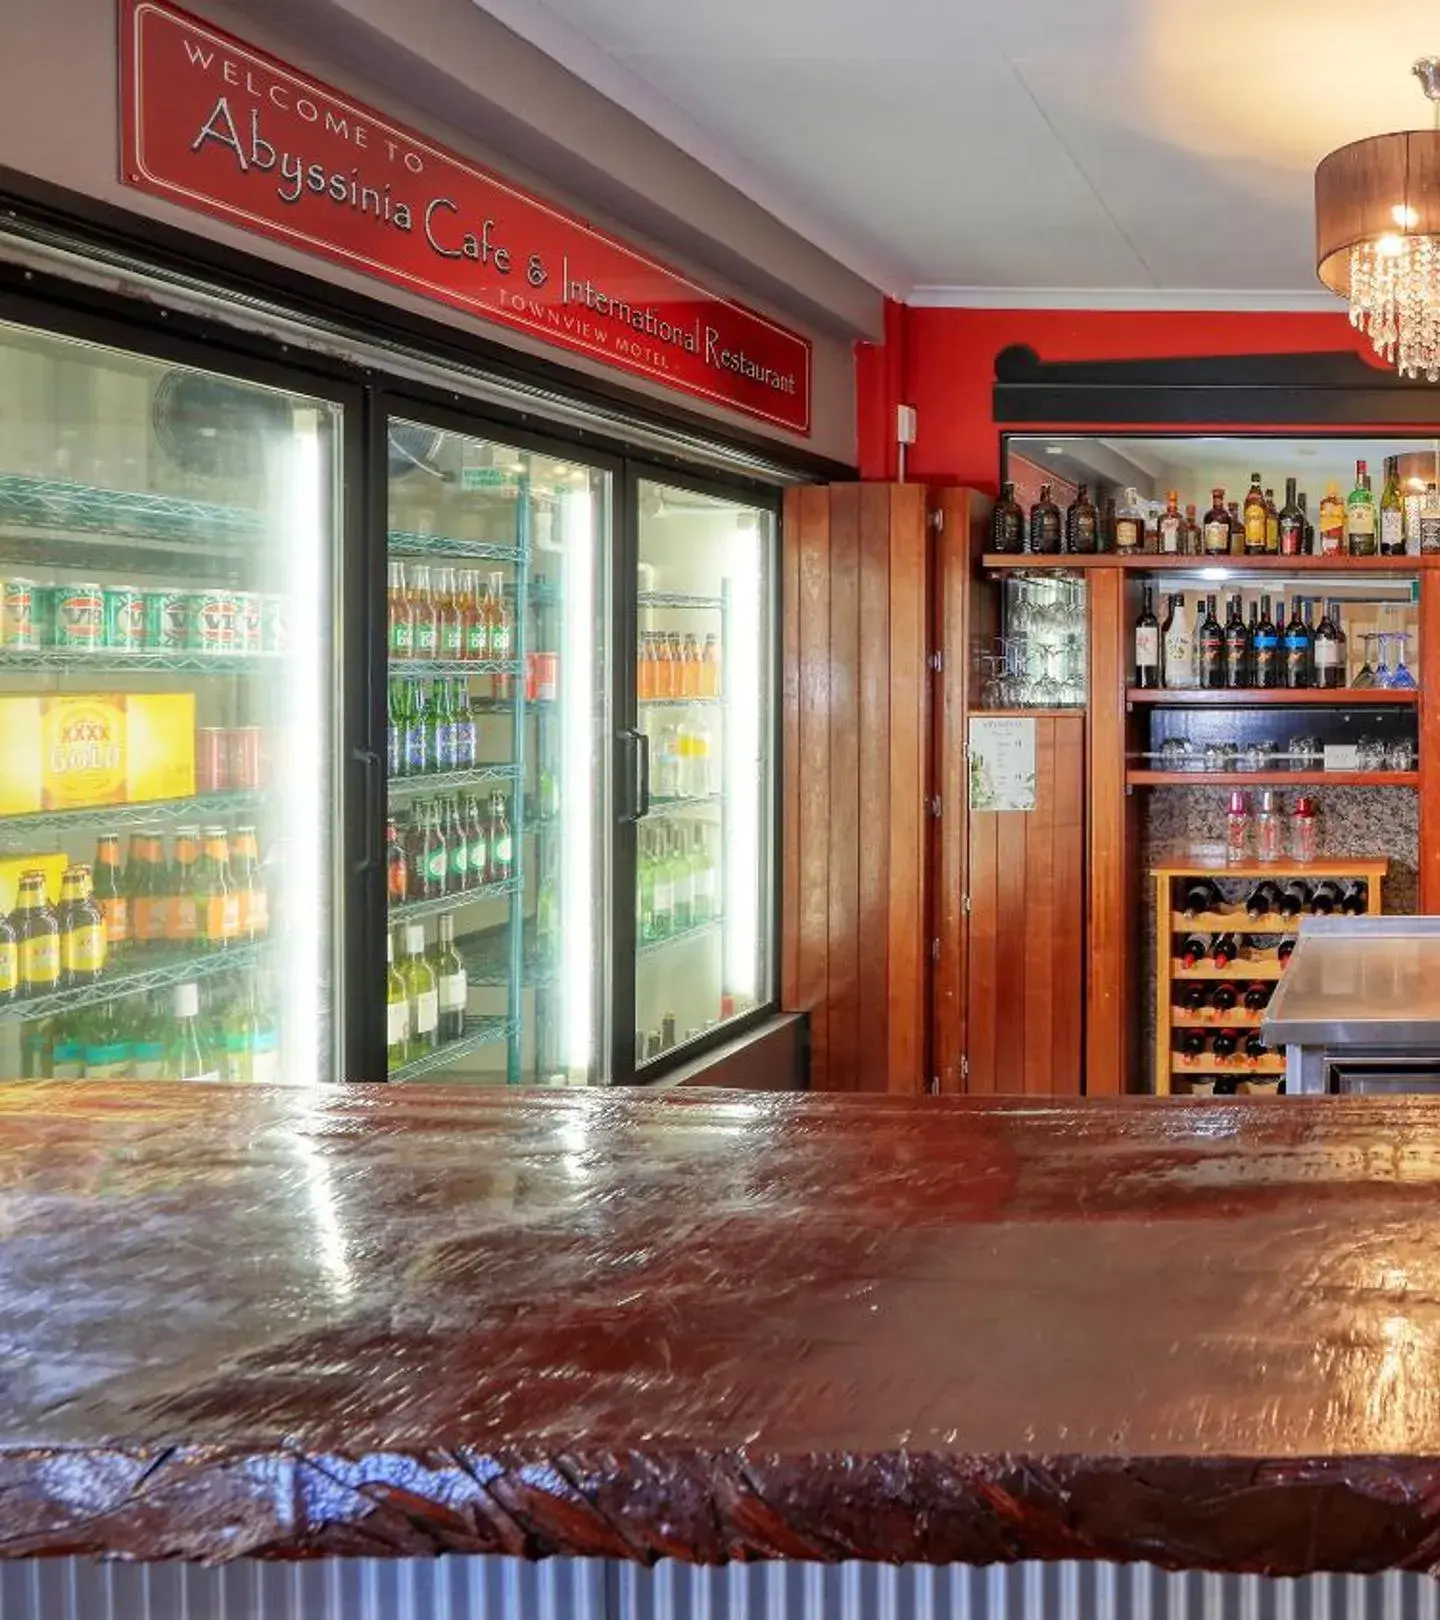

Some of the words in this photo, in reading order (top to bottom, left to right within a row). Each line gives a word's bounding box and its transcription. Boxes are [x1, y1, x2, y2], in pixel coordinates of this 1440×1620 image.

[183, 39, 368, 149] WELCOME
[384, 140, 424, 173] TO
[190, 96, 413, 232] Abyssinia
[424, 198, 511, 274] Cafe
[527, 252, 549, 287] &
[562, 255, 700, 355] International
[704, 325, 797, 396] Restaurant
[499, 289, 608, 343] TOWNVIEW
[615, 338, 669, 369] MOTEL
